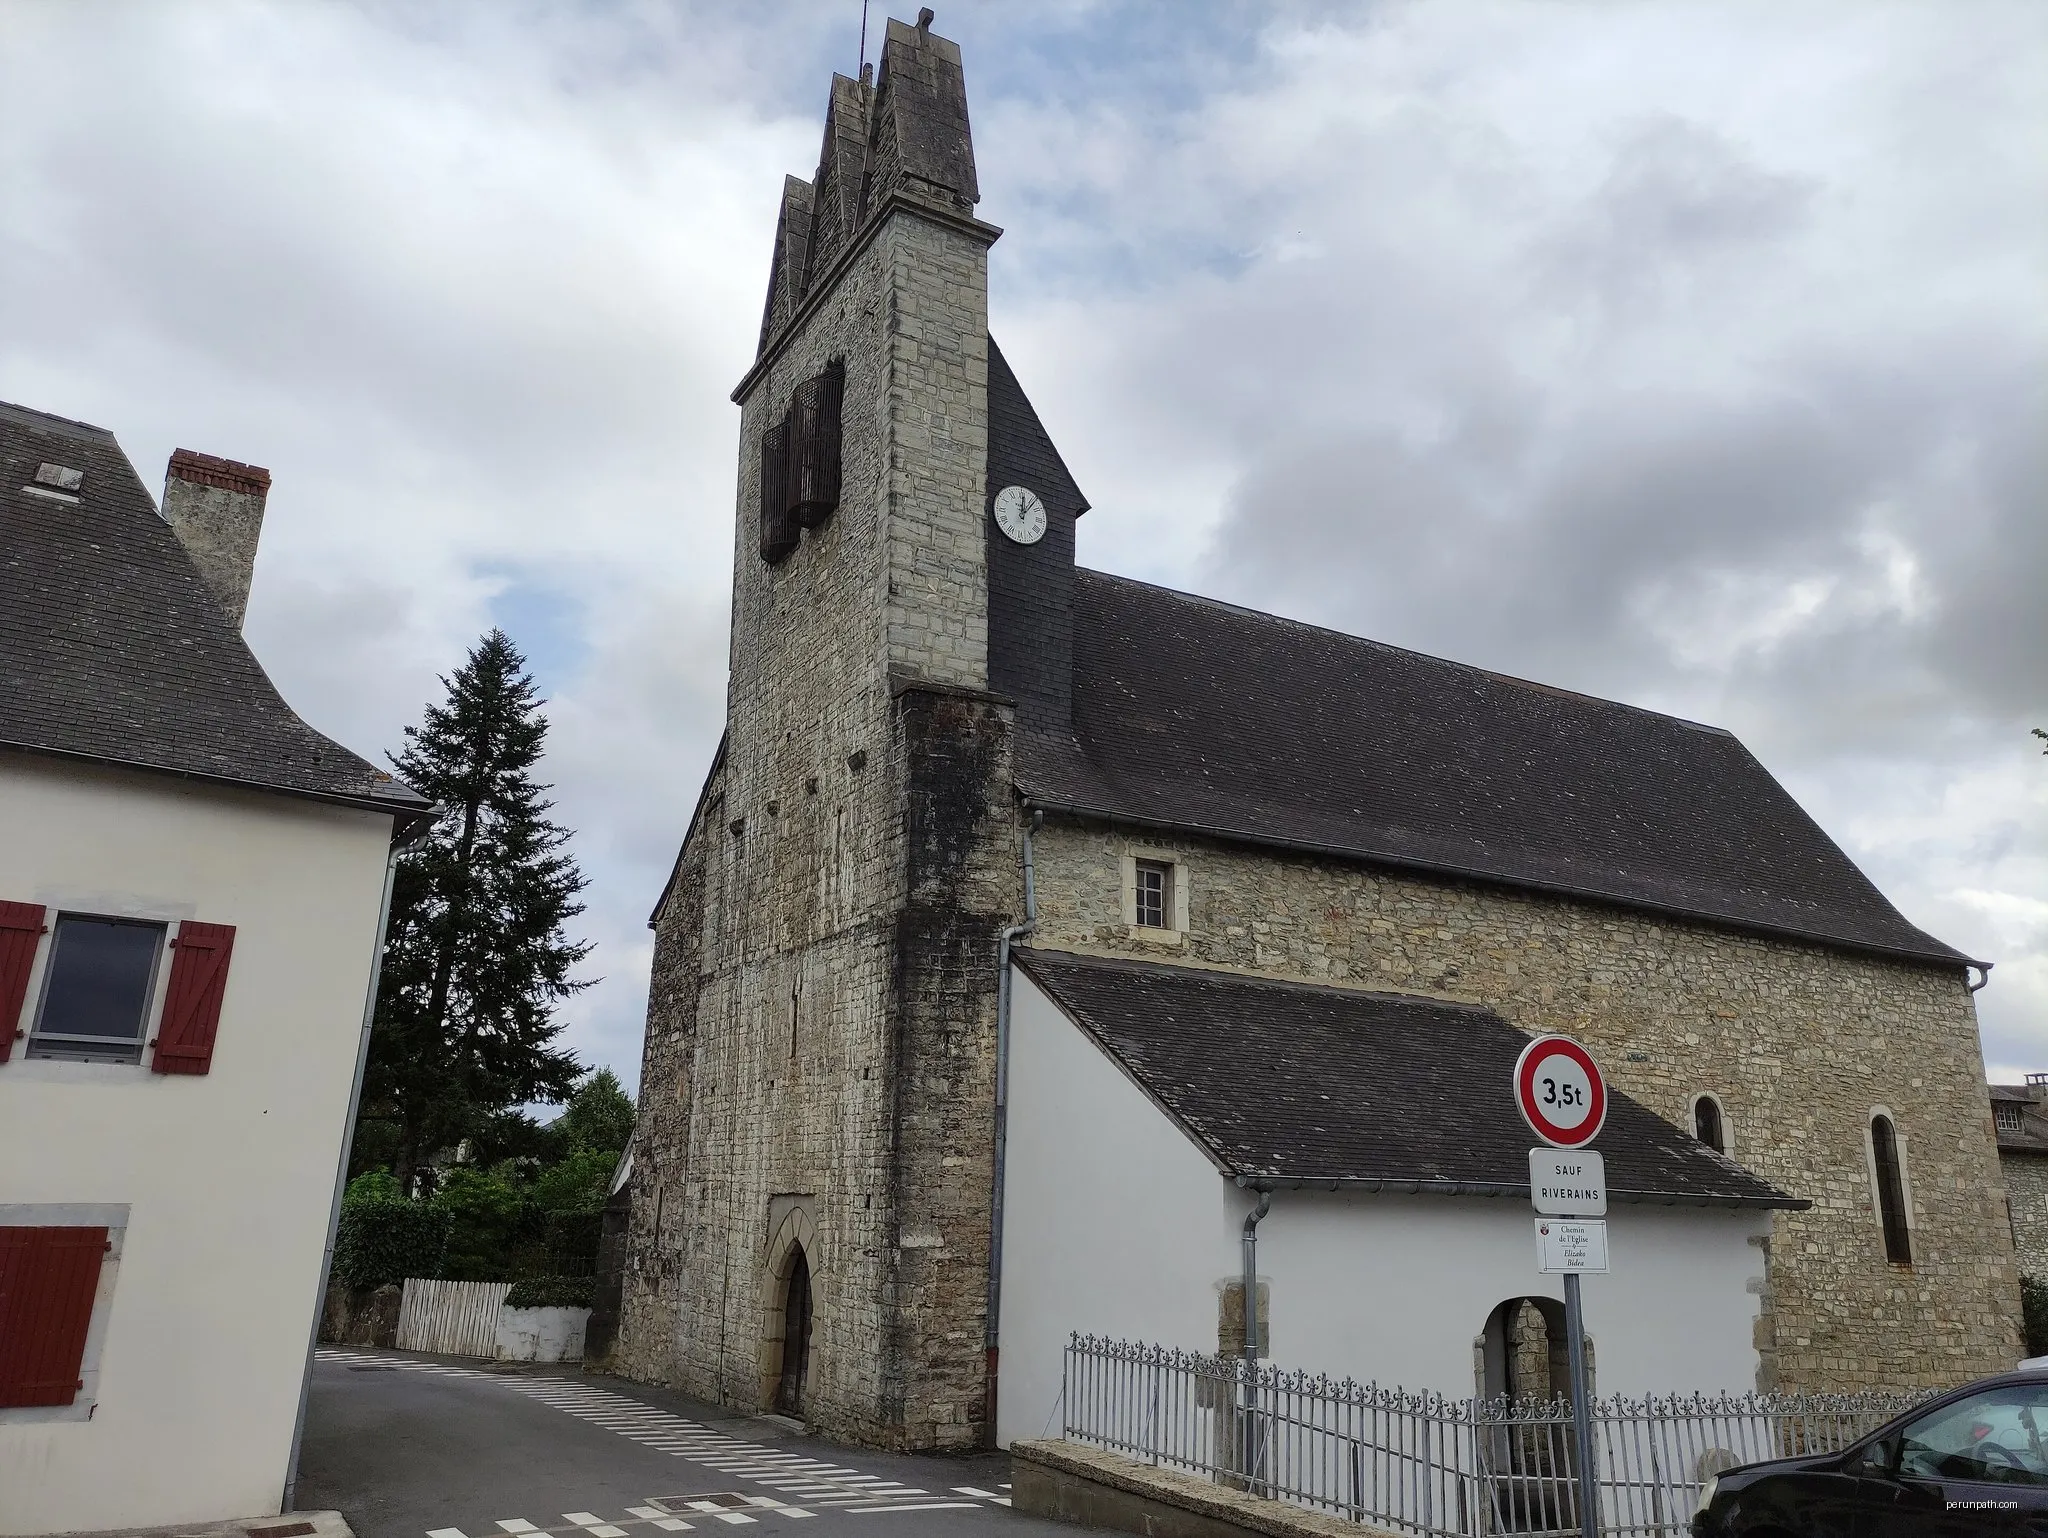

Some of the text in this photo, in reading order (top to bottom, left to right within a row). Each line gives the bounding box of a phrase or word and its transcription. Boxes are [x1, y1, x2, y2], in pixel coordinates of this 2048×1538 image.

[1542, 1077, 1583, 1109] 3,5t
[1555, 1165, 1582, 1176] SAUF
[1541, 1188, 1599, 1200] RIVERAINS
[1560, 1225, 1585, 1234] Chemin
